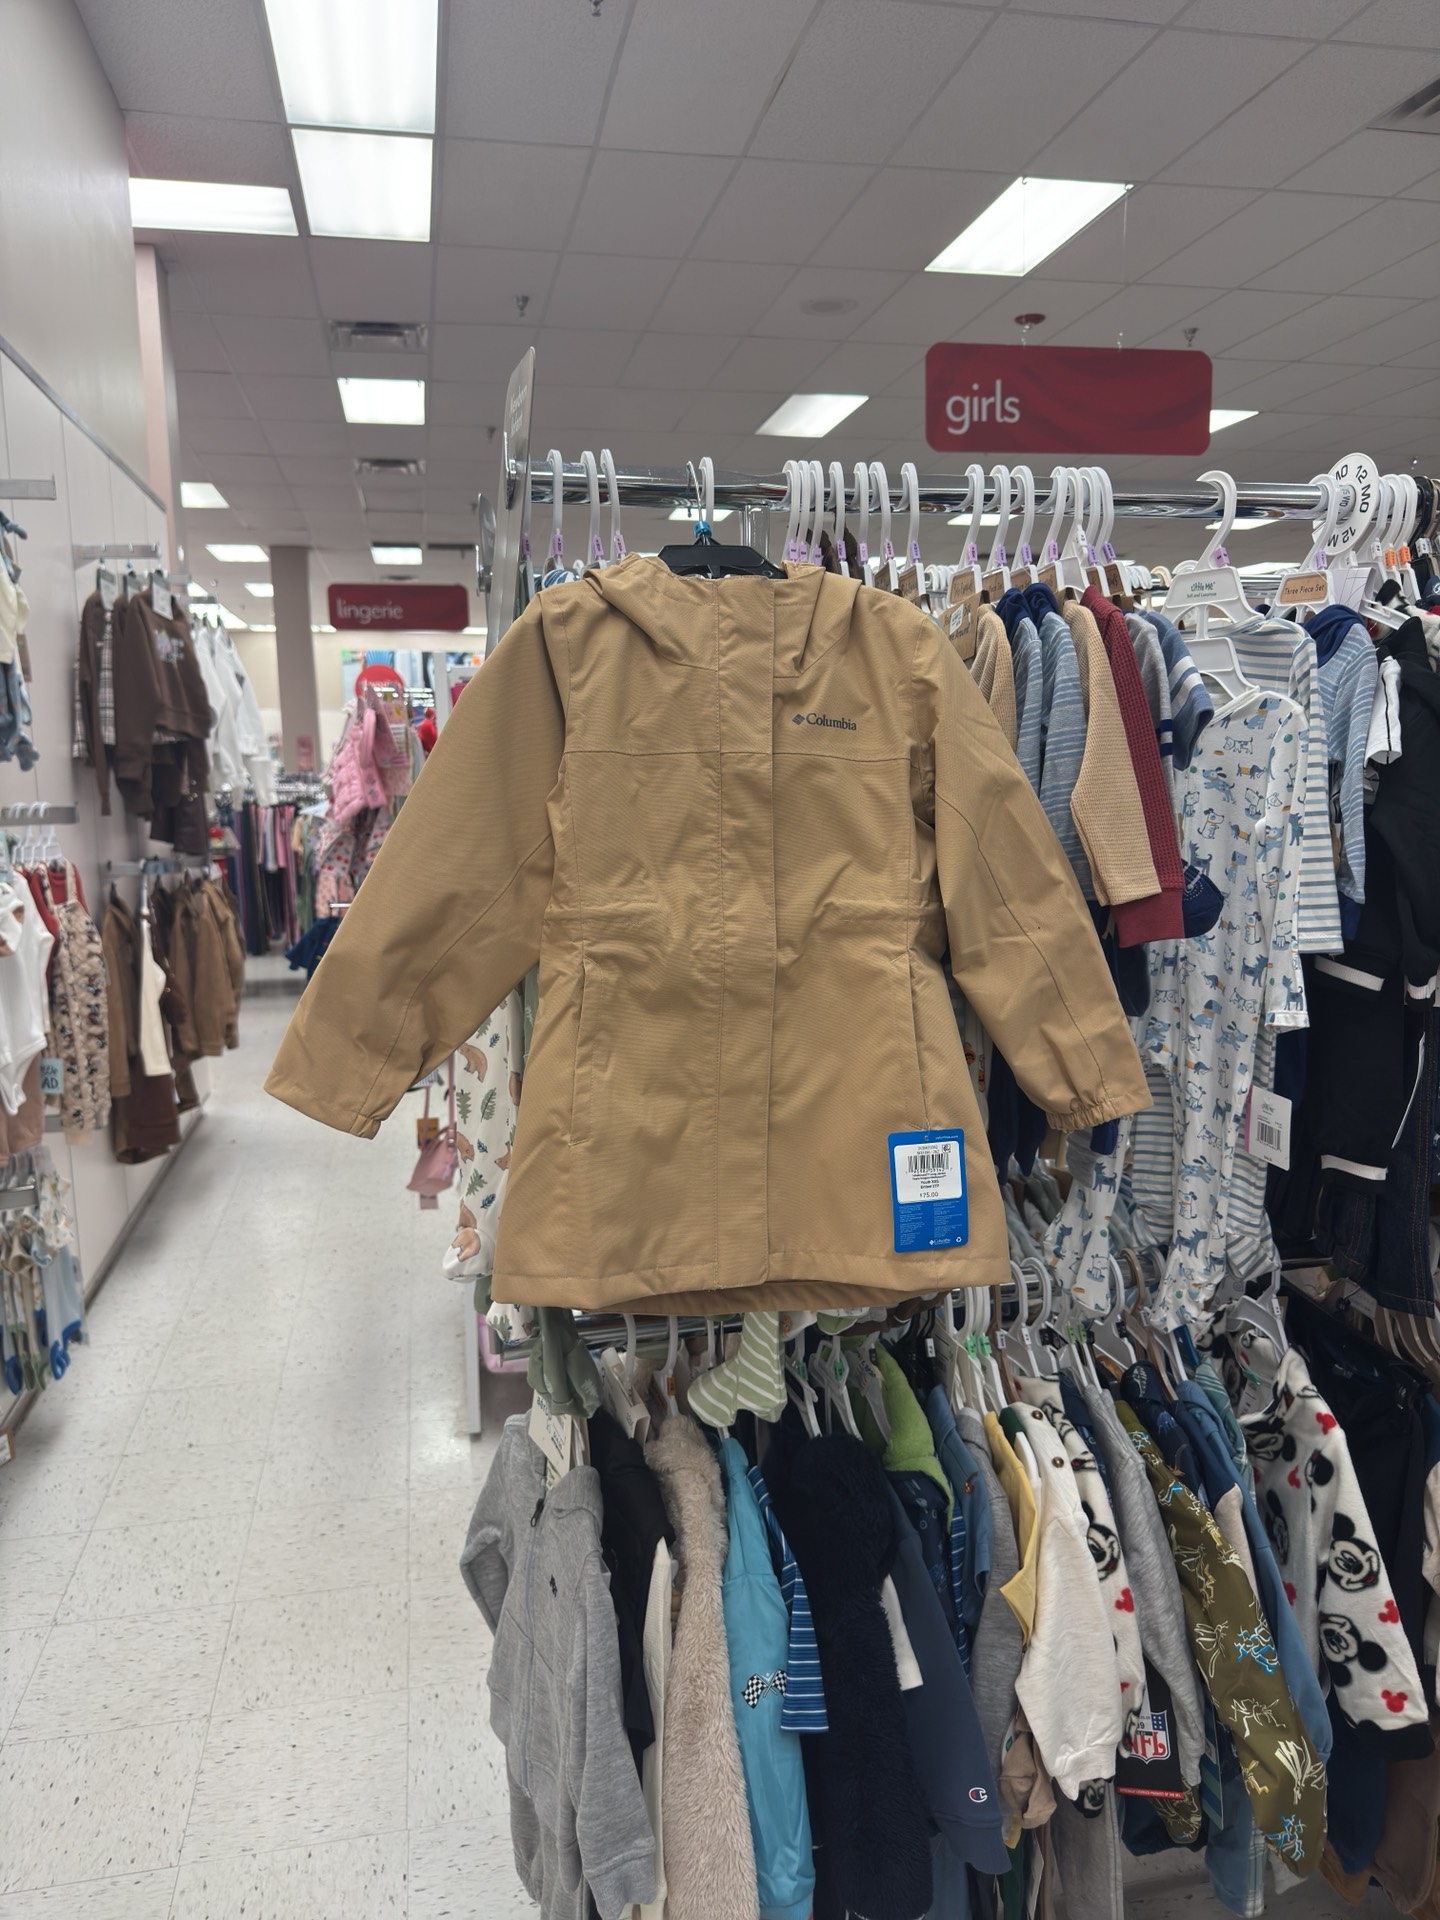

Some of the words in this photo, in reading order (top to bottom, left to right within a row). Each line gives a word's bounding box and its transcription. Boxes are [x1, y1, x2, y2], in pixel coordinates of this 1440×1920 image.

[945, 379, 1021, 435] girls
[1355, 465, 1368, 484] 12
[1360, 484, 1371, 513] MO
[1327, 534, 1339, 547] M
[1342, 526, 1356, 543] 12
[336, 597, 404, 625] lingerie
[806, 712, 857, 731] Columbia
